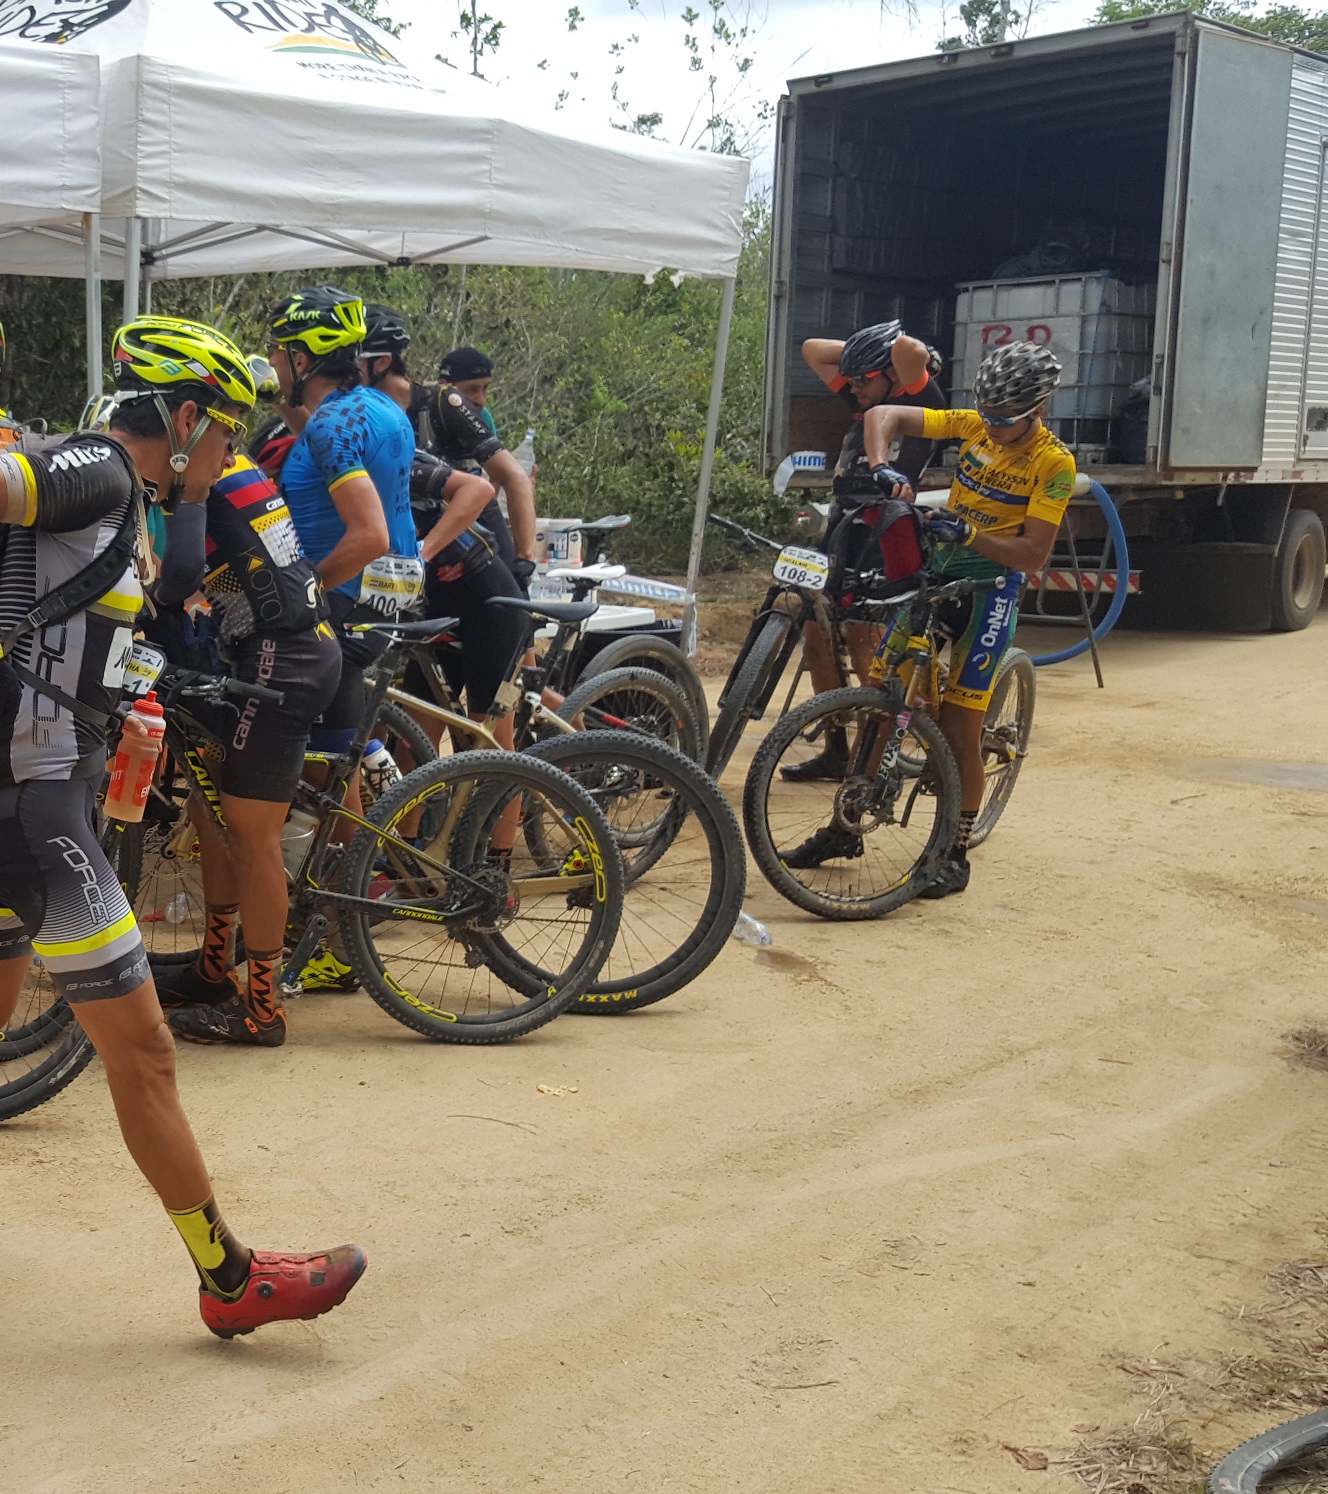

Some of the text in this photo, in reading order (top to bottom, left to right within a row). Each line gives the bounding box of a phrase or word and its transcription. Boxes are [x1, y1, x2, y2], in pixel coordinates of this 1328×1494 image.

[289, 310, 320, 321] KASK
[779, 564, 823, 588] 108-2
[980, 596, 1009, 648] OnNet
[232, 639, 276, 751] canndale
[945, 685, 985, 701] OCUS
[46, 835, 110, 925] FORCE
[392, 908, 446, 922] CANNONDALE
[579, 989, 639, 1004] MAXXI
